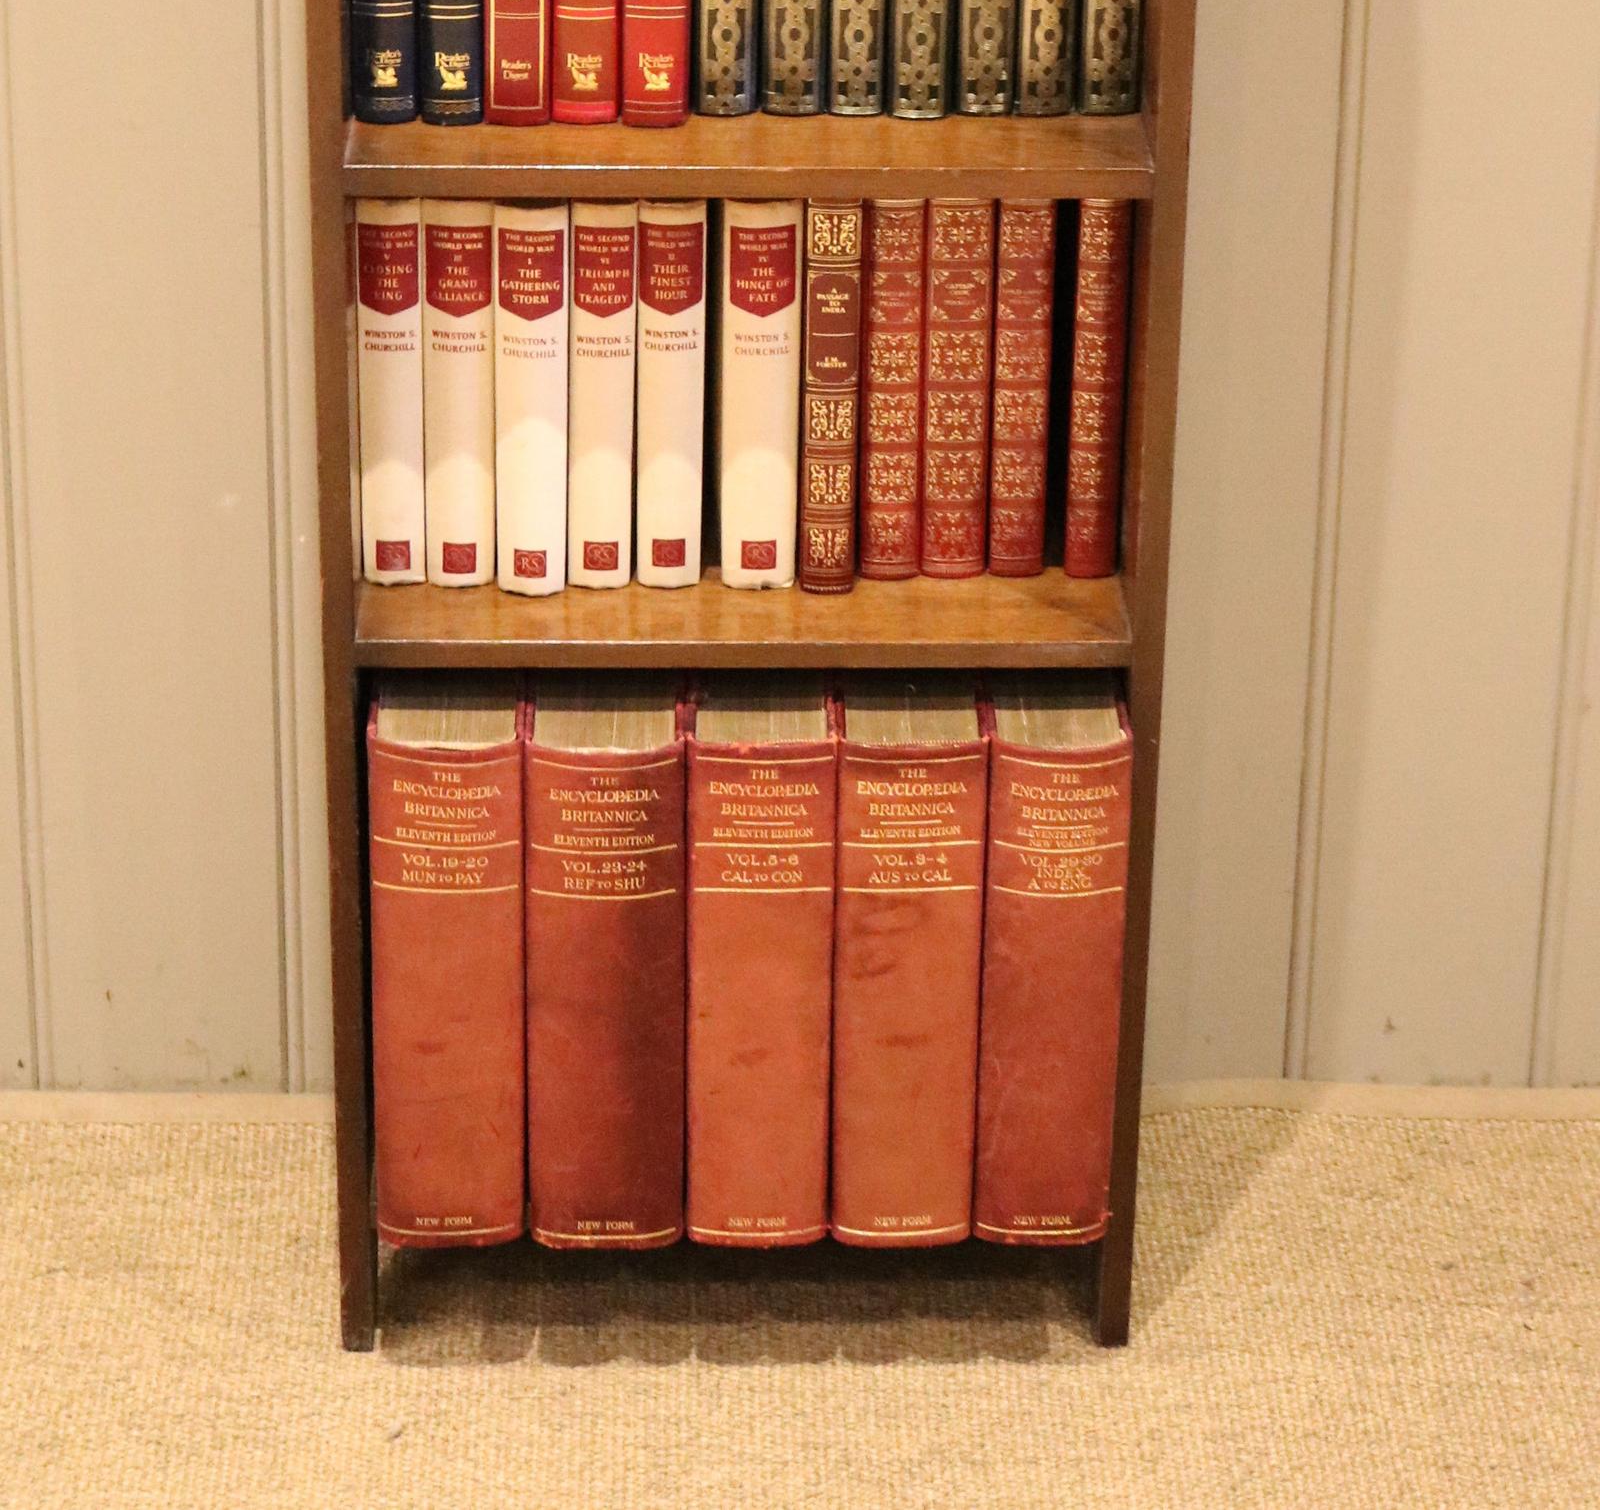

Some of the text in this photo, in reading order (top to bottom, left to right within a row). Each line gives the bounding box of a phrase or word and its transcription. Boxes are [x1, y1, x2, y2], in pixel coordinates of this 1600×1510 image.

[505, 234, 555, 242] THE SECOND
[579, 234, 630, 242] THE SECOND
[739, 232, 788, 240] THE SECOND
[433, 242, 462, 250] WORLD
[506, 244, 534, 253] WORLD
[579, 244, 608, 253] WORLD
[648, 240, 675, 248] WORLD
[739, 243, 767, 251] WORLD
[446, 267, 469, 275] THE
[518, 269, 541, 278] THE
[579, 269, 630, 277] TRIUMPH
[653, 264, 689, 274] THEIR
[752, 267, 775, 276] THE
[378, 279, 399, 288] THE
[439, 279, 477, 289] GRAND
[501, 280, 560, 291] GATHERING
[650, 276, 692, 286] FINEST
[736, 279, 790, 290] HINGE OF
[593, 282, 615, 292] AND
[433, 292, 485, 302] ALLIANCE
[512, 295, 549, 304] STORM
[580, 294, 627, 304] TRAGEDY
[655, 290, 688, 300] HOUR
[749, 293, 777, 302] FATE
[365, 330, 406, 338] WINSTON
[432, 330, 475, 339] WINSTON
[645, 329, 689, 338] WINSTON
[735, 333, 779, 342] WINSTON
[503, 336, 546, 345] WINSTON
[577, 335, 621, 344] WINSTON
[365, 343, 415, 351] CHURCHILL
[432, 343, 486, 352] CHURCHILL
[645, 342, 697, 351] CHURCHILL
[735, 346, 789, 355] CHURCHILL
[503, 349, 557, 358] CHURCHILL
[577, 348, 631, 357] CHURCHILL
[433, 772, 461, 782] THE
[751, 770, 779, 780] THE
[899, 769, 927, 778] THE
[1052, 773, 1080, 784] THE
[591, 777, 619, 786] THE
[393, 780, 500, 800] ENCYCLOPÆDIA
[710, 782, 819, 797] ENCYCLOPÆDIA
[857, 781, 967, 796] ENCYCLOPÆDIA
[1010, 783, 1119, 802] ENCYCLOPÆDIA
[550, 789, 659, 803] ENCYCLOPÆDIA
[404, 801, 489, 818] BRITANNICA
[721, 802, 808, 816] BRITANNICA
[869, 802, 955, 816] BRITANNICA
[1022, 806, 1106, 821] BRITANNICA
[561, 809, 648, 822] BRITANNICA
[396, 828, 496, 842] ELEVENTH EDITION
[713, 827, 814, 838] ELEVENTH EDITION
[861, 825, 960, 838] ELEVENTH EDITION
[1017, 827, 1069, 839] ELEVENTH
[554, 834, 655, 846] ELEVENTH EDITION
[402, 871, 435, 883] MUN
[455, 872, 484, 884] PAY
[772, 871, 802, 883] CON
[869, 871, 900, 883] AUS
[922, 869, 952, 882] CAL
[1037, 868, 1086, 879] INDEX
[564, 878, 593, 890] REF
[614, 877, 646, 890] SHU
[1028, 879, 1040, 890] A
[1060, 878, 1092, 890] ENG
[416, 1216, 472, 1226] NEW FORM
[578, 1221, 634, 1230] NEW FORM
[729, 1217, 785, 1227] NEW FORM
[874, 1216, 932, 1227] NEW FORM
[1013, 1216, 1071, 1225] NEW FORM
